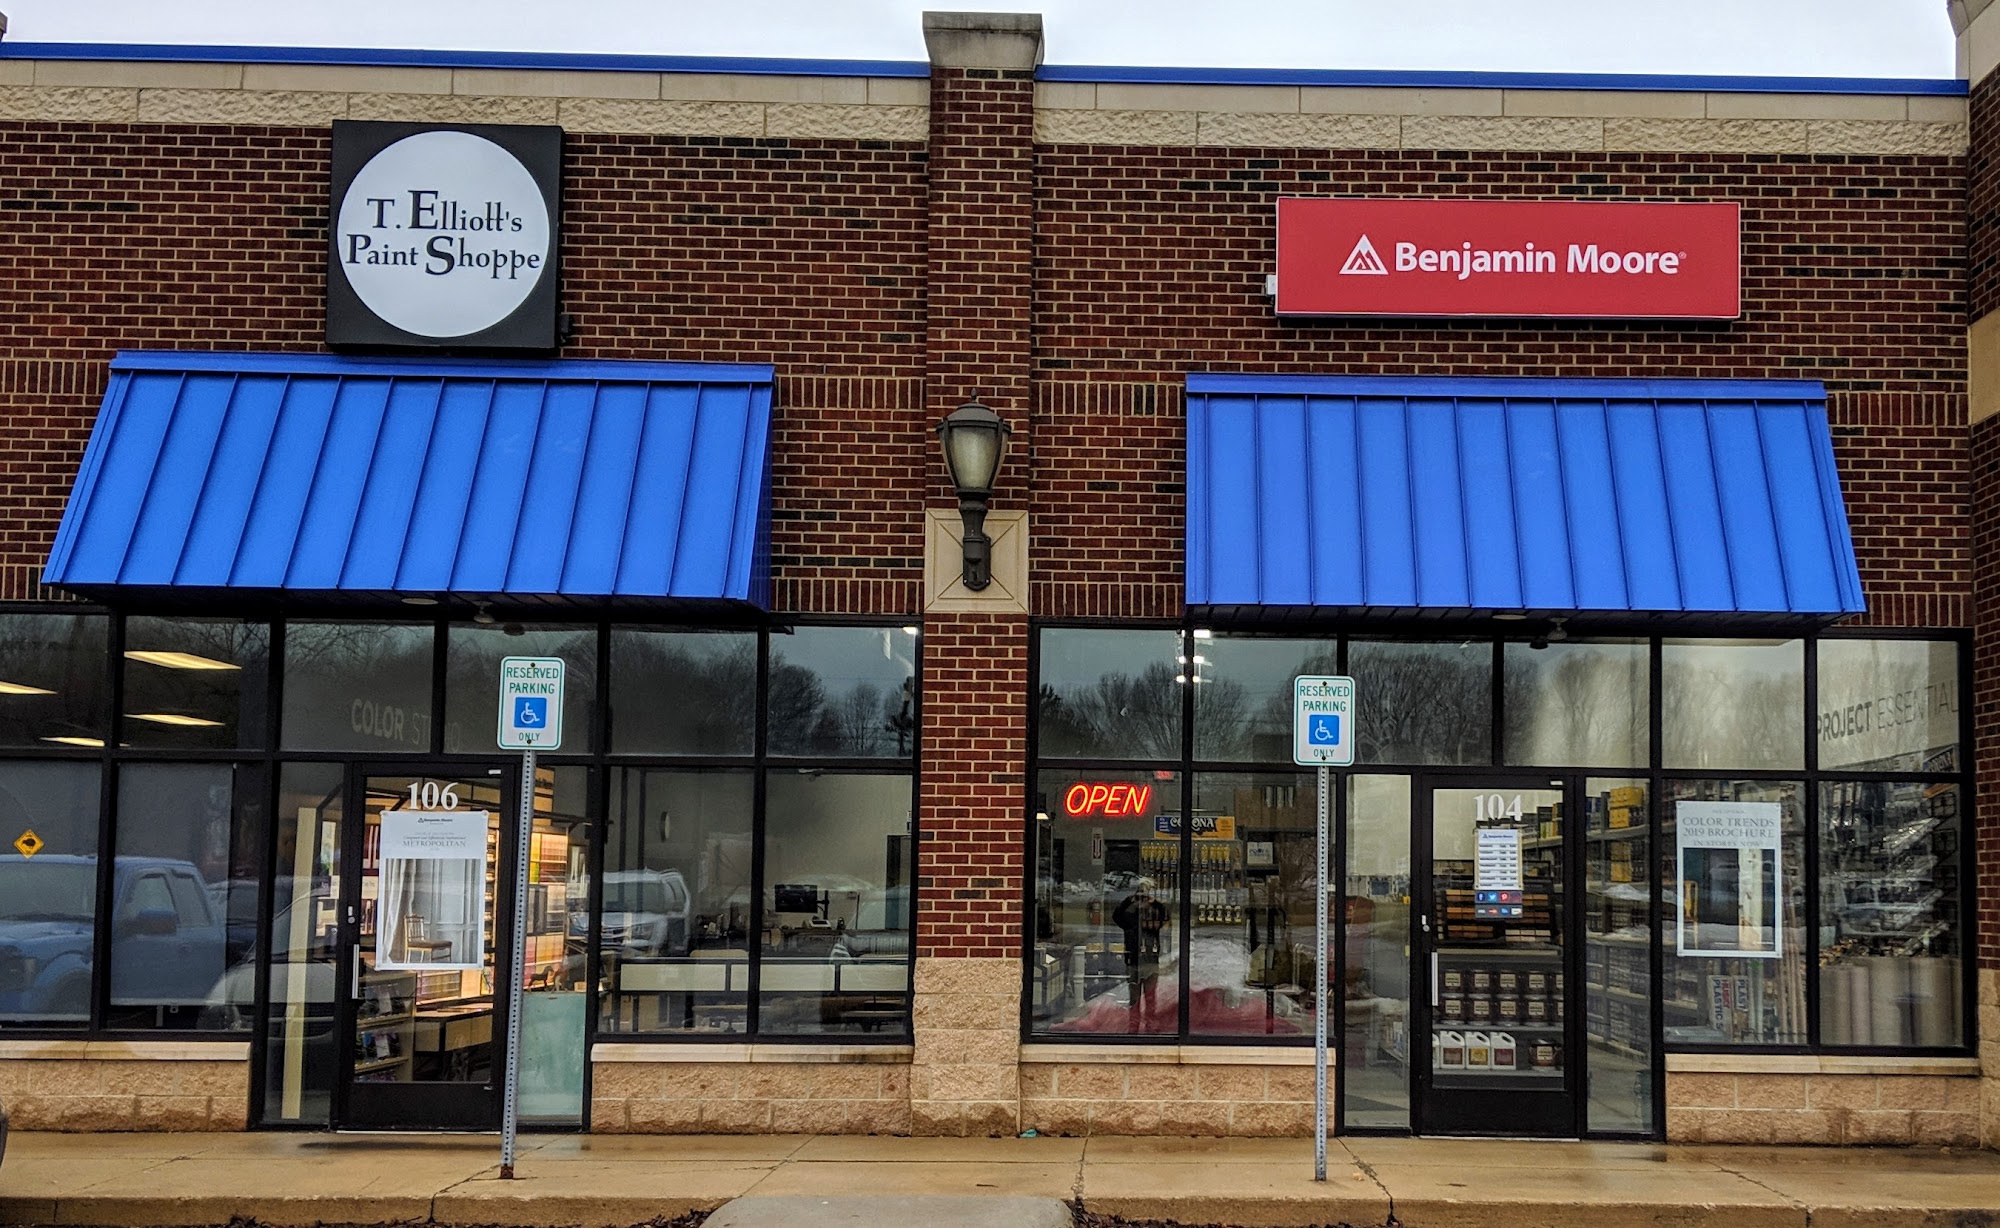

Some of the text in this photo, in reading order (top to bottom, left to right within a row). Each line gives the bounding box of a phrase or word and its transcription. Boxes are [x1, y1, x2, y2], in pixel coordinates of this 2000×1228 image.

[367, 190, 523, 232] T. Elliott's
[345, 234, 541, 280] Paint Shoppe
[1395, 241, 1556, 281] Benjamin
[506, 667, 559, 679] RESERVED
[509, 682, 555, 695] PARKING
[1299, 685, 1350, 697] RESERVED
[1303, 700, 1347, 713] PARKING
[351, 698, 404, 741] COLOR
[1817, 701, 1873, 742] PROJECT
[518, 732, 541, 742] ONLY
[1313, 748, 1335, 758] ONLY
[407, 781, 459, 811] 106
[1066, 784, 1148, 815] OPEN
[1473, 793, 1523, 822] 104
[1170, 816, 1215, 831] COONA
[1682, 816, 1775, 828] COLOR TRENDS
[1682, 828, 1775, 838] 2019 BROCHURE
[403, 840, 466, 848] METROPOLITAN
[1713, 979, 1723, 1020] PLASTIC
